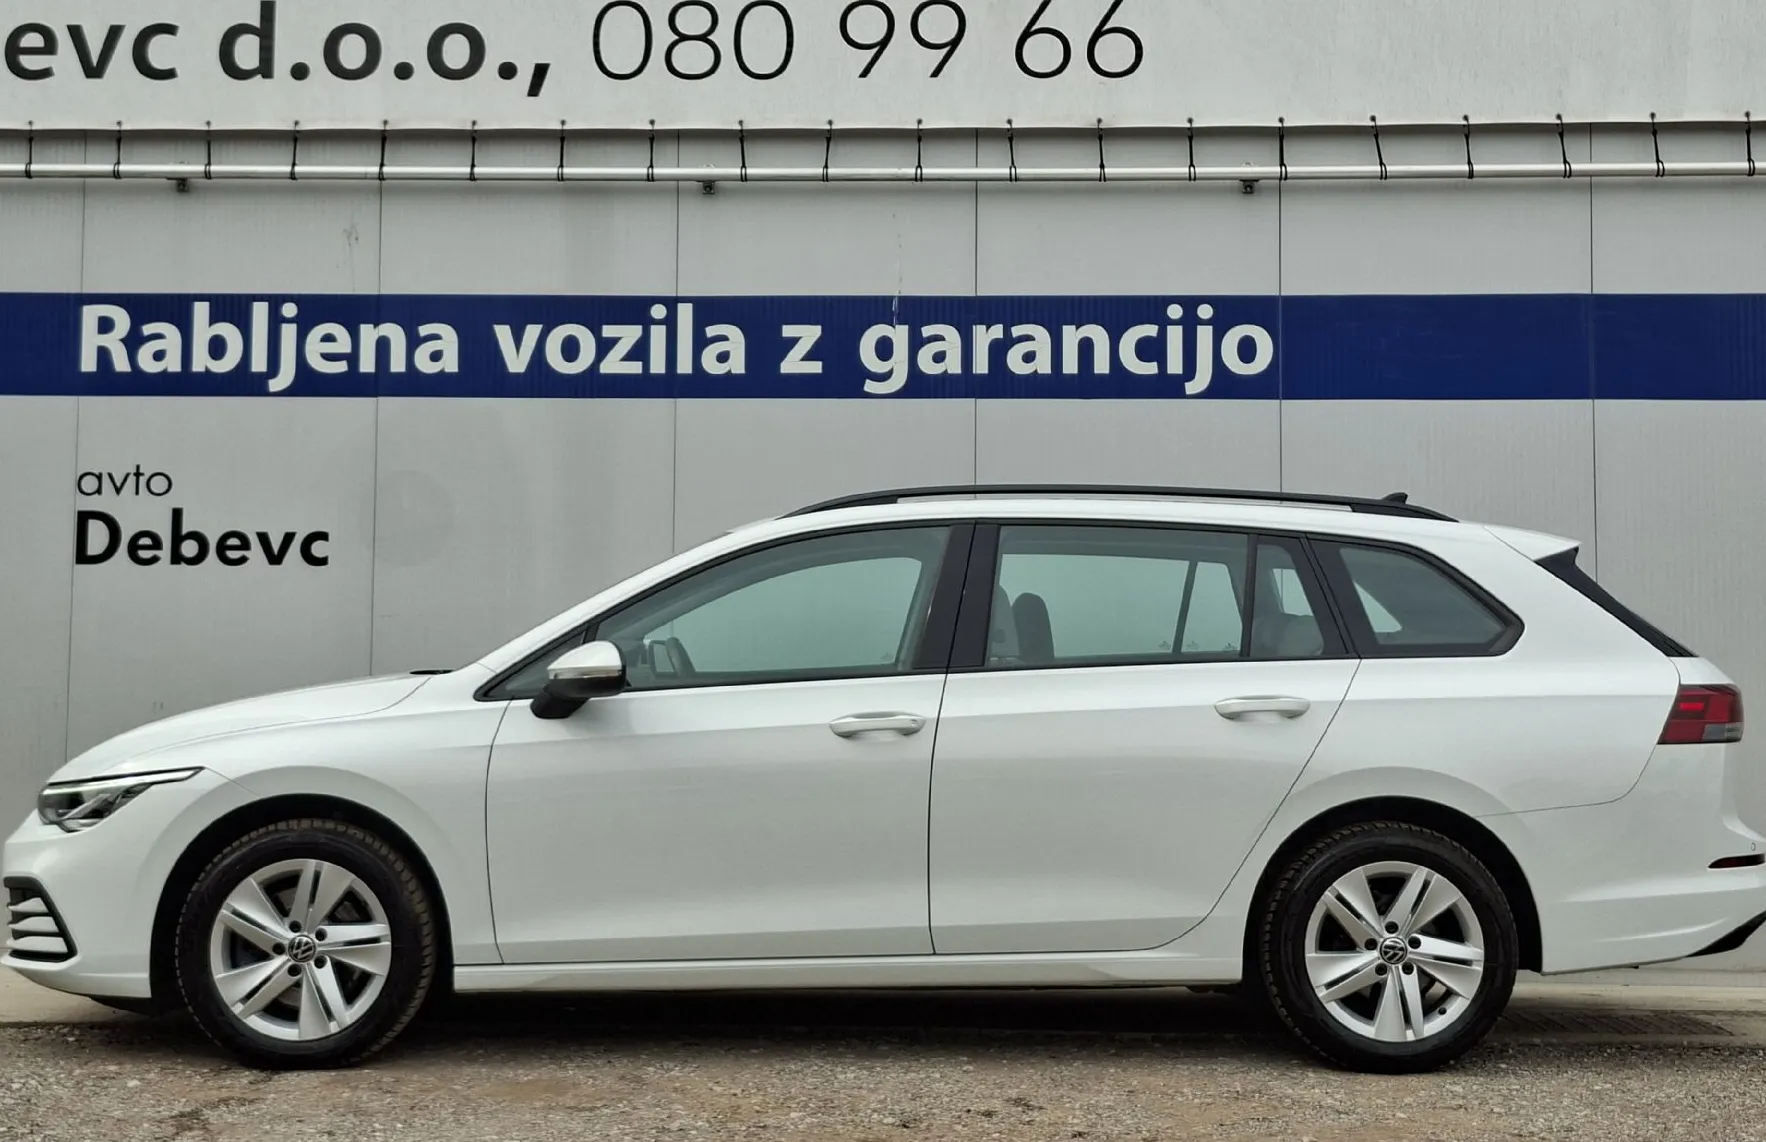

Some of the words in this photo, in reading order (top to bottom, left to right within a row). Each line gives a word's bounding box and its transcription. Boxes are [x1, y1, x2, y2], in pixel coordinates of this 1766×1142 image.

[4, 22, 180, 81] evc
[218, 0, 551, 97] d.o.o.,
[592, 0, 795, 81] 080
[838, 0, 967, 79] 99
[1014, 0, 1144, 79] 66
[79, 301, 460, 394] Rabljena
[493, 302, 747, 375] vozila
[779, 324, 823, 375] z
[858, 303, 1275, 395] garancijo
[76, 463, 173, 497] avto
[75, 507, 330, 567] Debevc
